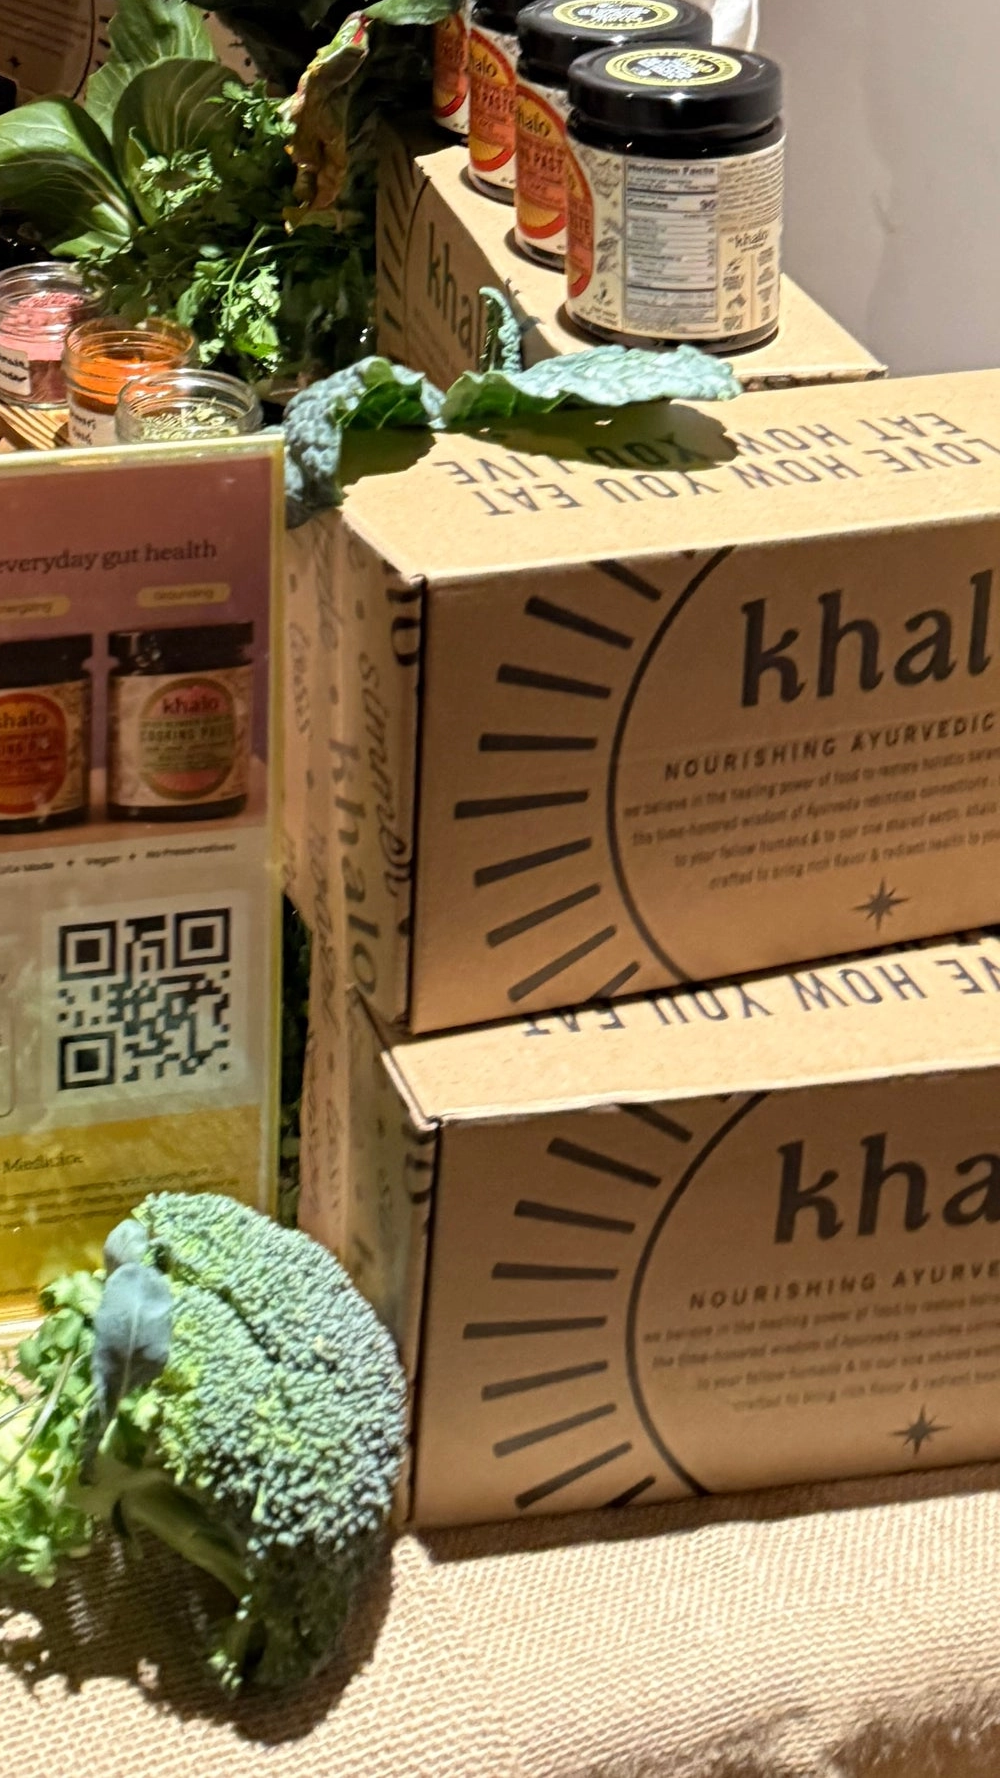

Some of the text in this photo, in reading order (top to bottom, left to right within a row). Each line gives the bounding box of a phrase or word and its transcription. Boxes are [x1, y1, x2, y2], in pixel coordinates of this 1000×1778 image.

[427, 221, 481, 371] khal
[585, 430, 710, 469] YOU
[735, 423, 852, 457] HOW
[856, 412, 967, 442] EAT
[471, 438, 1000, 517] LOVE HOW YOU EAT
[101, 549, 139, 572] gut
[144, 539, 218, 564] health
[740, 568, 995, 708] khal
[162, 695, 220, 715] khalo
[664, 712, 995, 782] NOURISHING AYURVEDIC
[329, 738, 379, 996] khalo
[648, 981, 774, 1026] YOU
[789, 963, 929, 1013] HOW
[774, 1131, 1000, 1244] kha
[689, 1259, 1000, 1310] NOURISHING AYURVE
